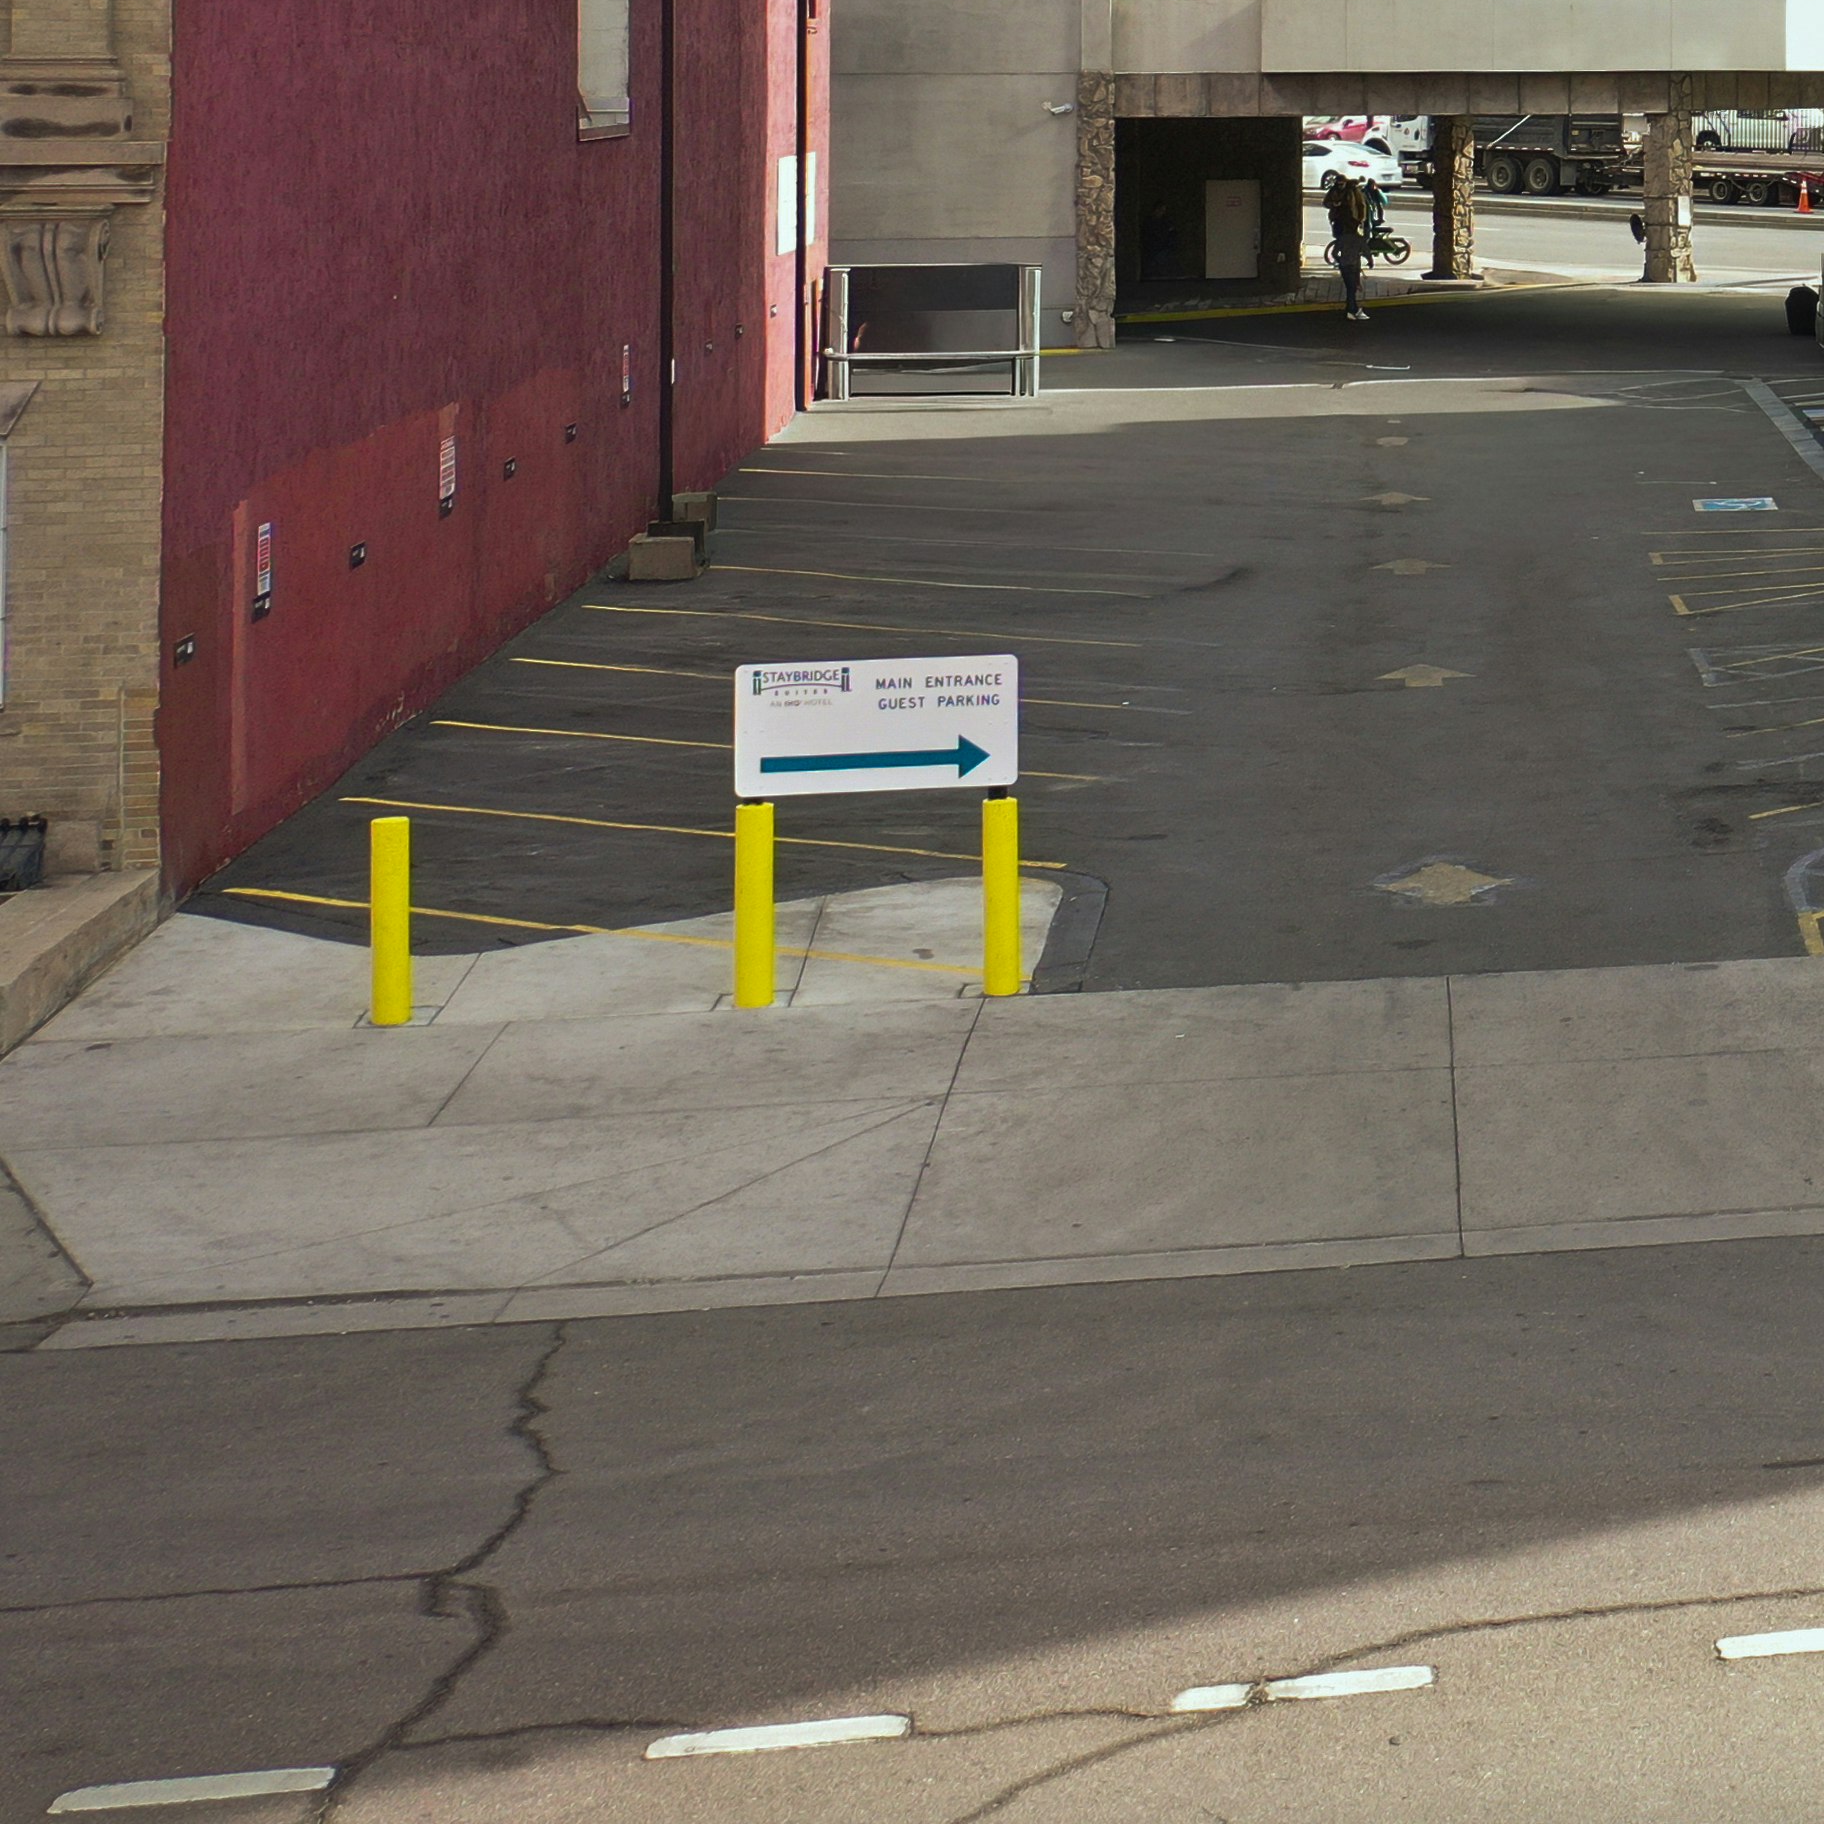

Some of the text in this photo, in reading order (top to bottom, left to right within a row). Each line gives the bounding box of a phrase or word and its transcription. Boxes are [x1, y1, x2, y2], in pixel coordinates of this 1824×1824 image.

[763, 669, 840, 683] STAYBRIDGE
[875, 673, 1003, 690] MAIN ENTRANCE
[878, 693, 1001, 710] GUEST PARKING
